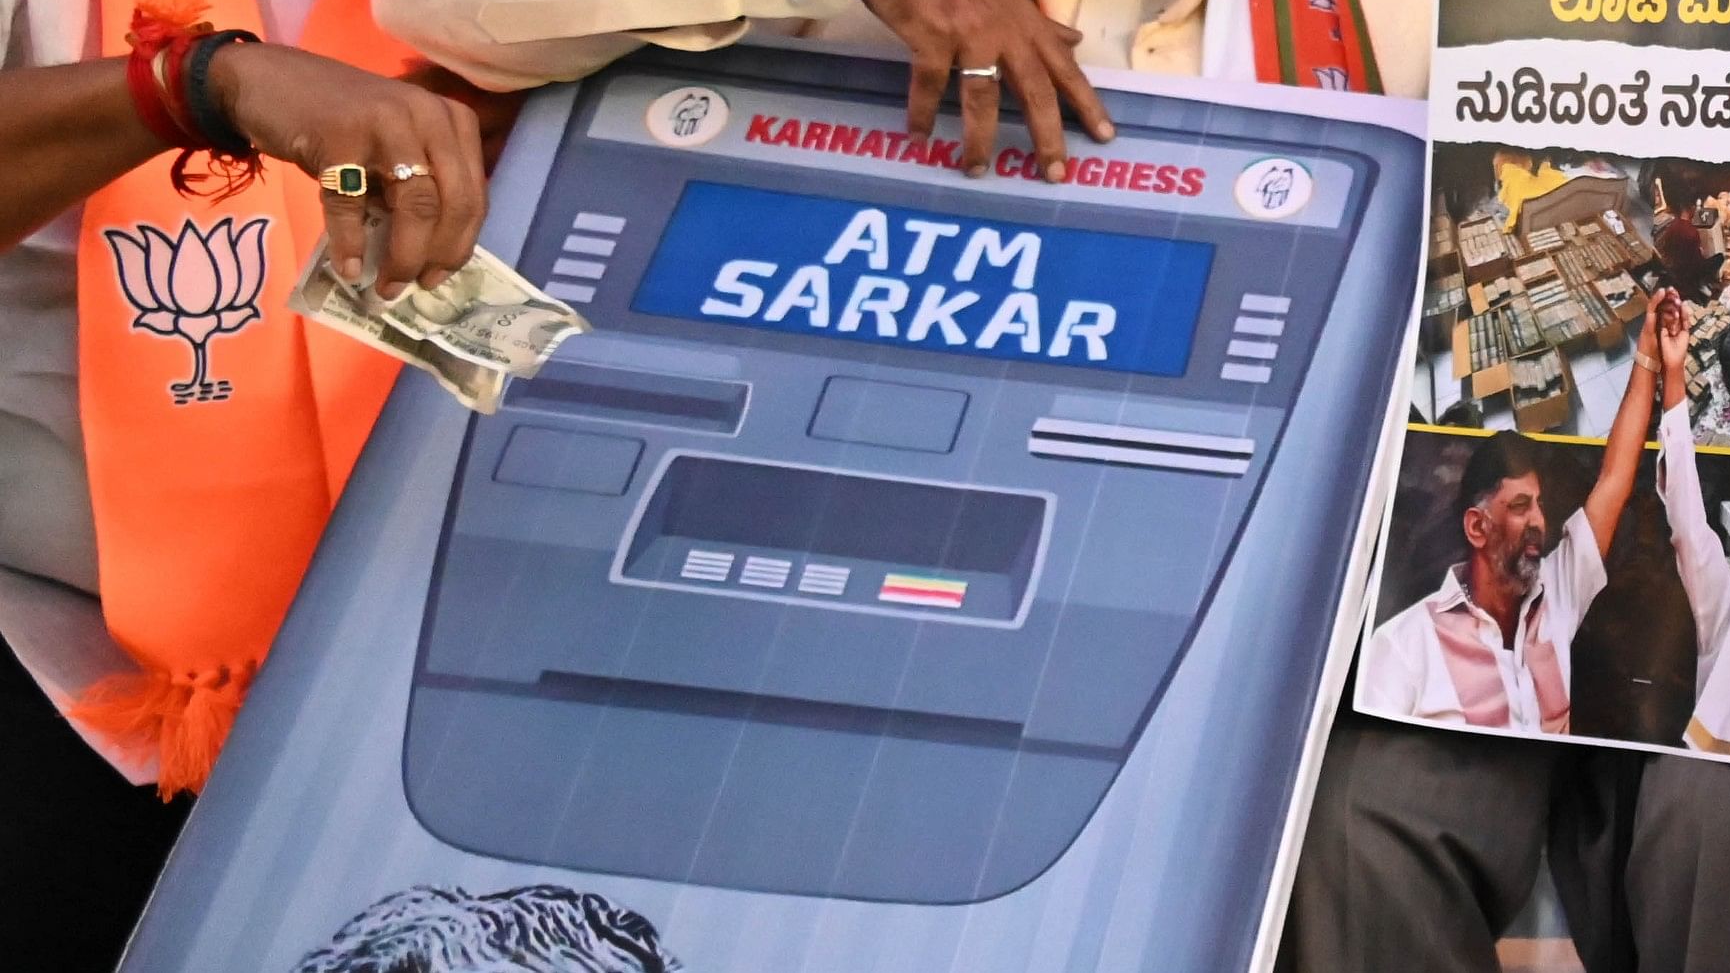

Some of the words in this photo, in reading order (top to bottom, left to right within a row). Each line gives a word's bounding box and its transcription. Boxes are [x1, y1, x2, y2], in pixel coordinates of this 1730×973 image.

[1455, 67, 1650, 126] ನುಡಿದಂತೆ
[746, 113, 970, 170] KARNATAK
[824, 208, 1042, 290] ATM
[700, 259, 1117, 361] SARKAR
